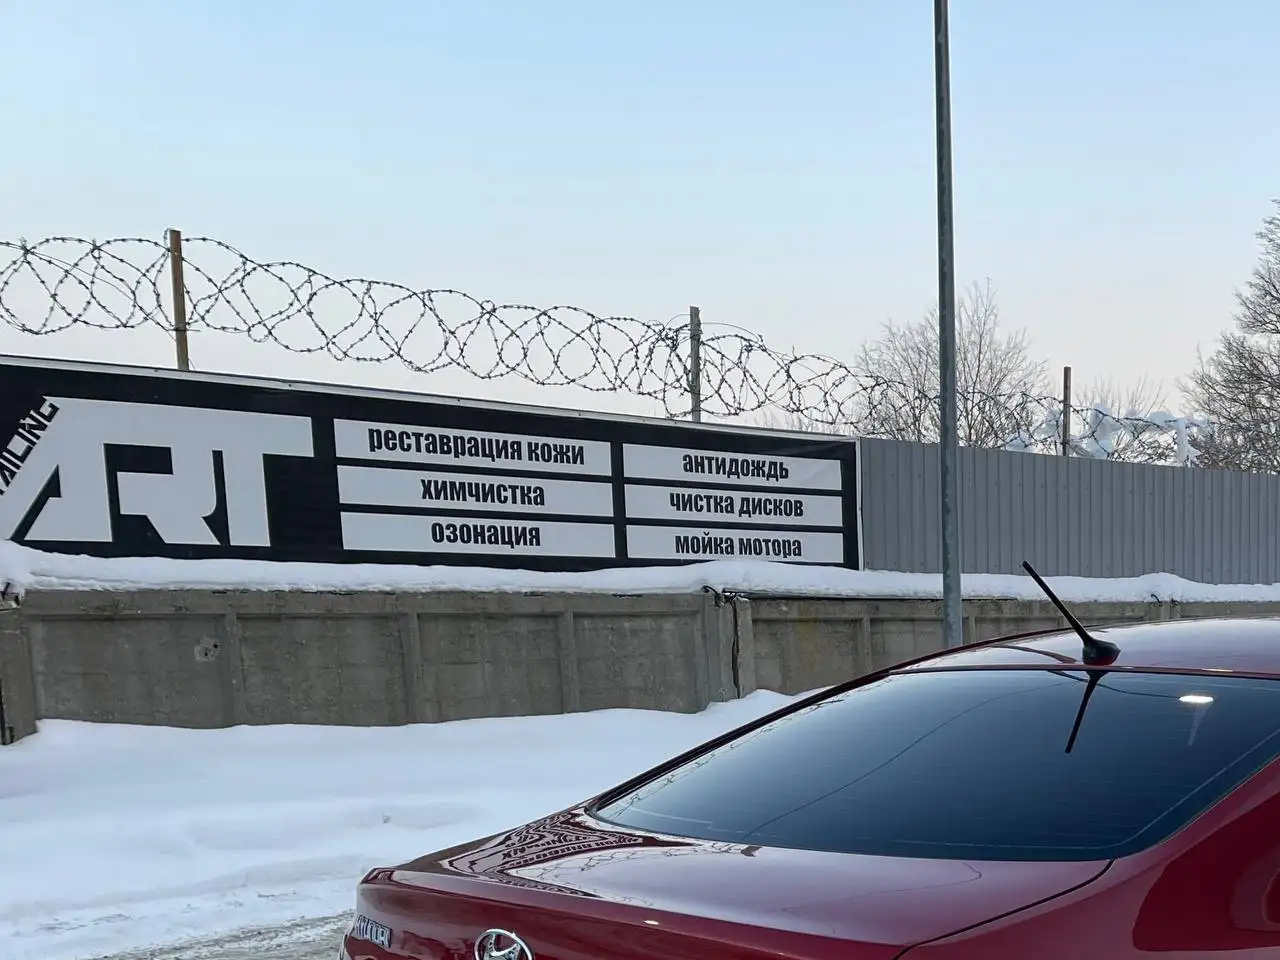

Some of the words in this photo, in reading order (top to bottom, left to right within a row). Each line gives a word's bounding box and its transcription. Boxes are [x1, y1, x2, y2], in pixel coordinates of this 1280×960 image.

[0, 400, 60, 496] AILING
[368, 428, 522, 462] реставрация
[527, 441, 585, 465] кожи
[0, 396, 315, 547] ART
[682, 454, 789, 482] антидождь
[420, 478, 545, 506] химчистка
[669, 492, 735, 514] чистка
[738, 496, 804, 518] дисков
[431, 522, 541, 549] озонация
[674, 531, 735, 555] мойка
[738, 537, 802, 558] мотора
